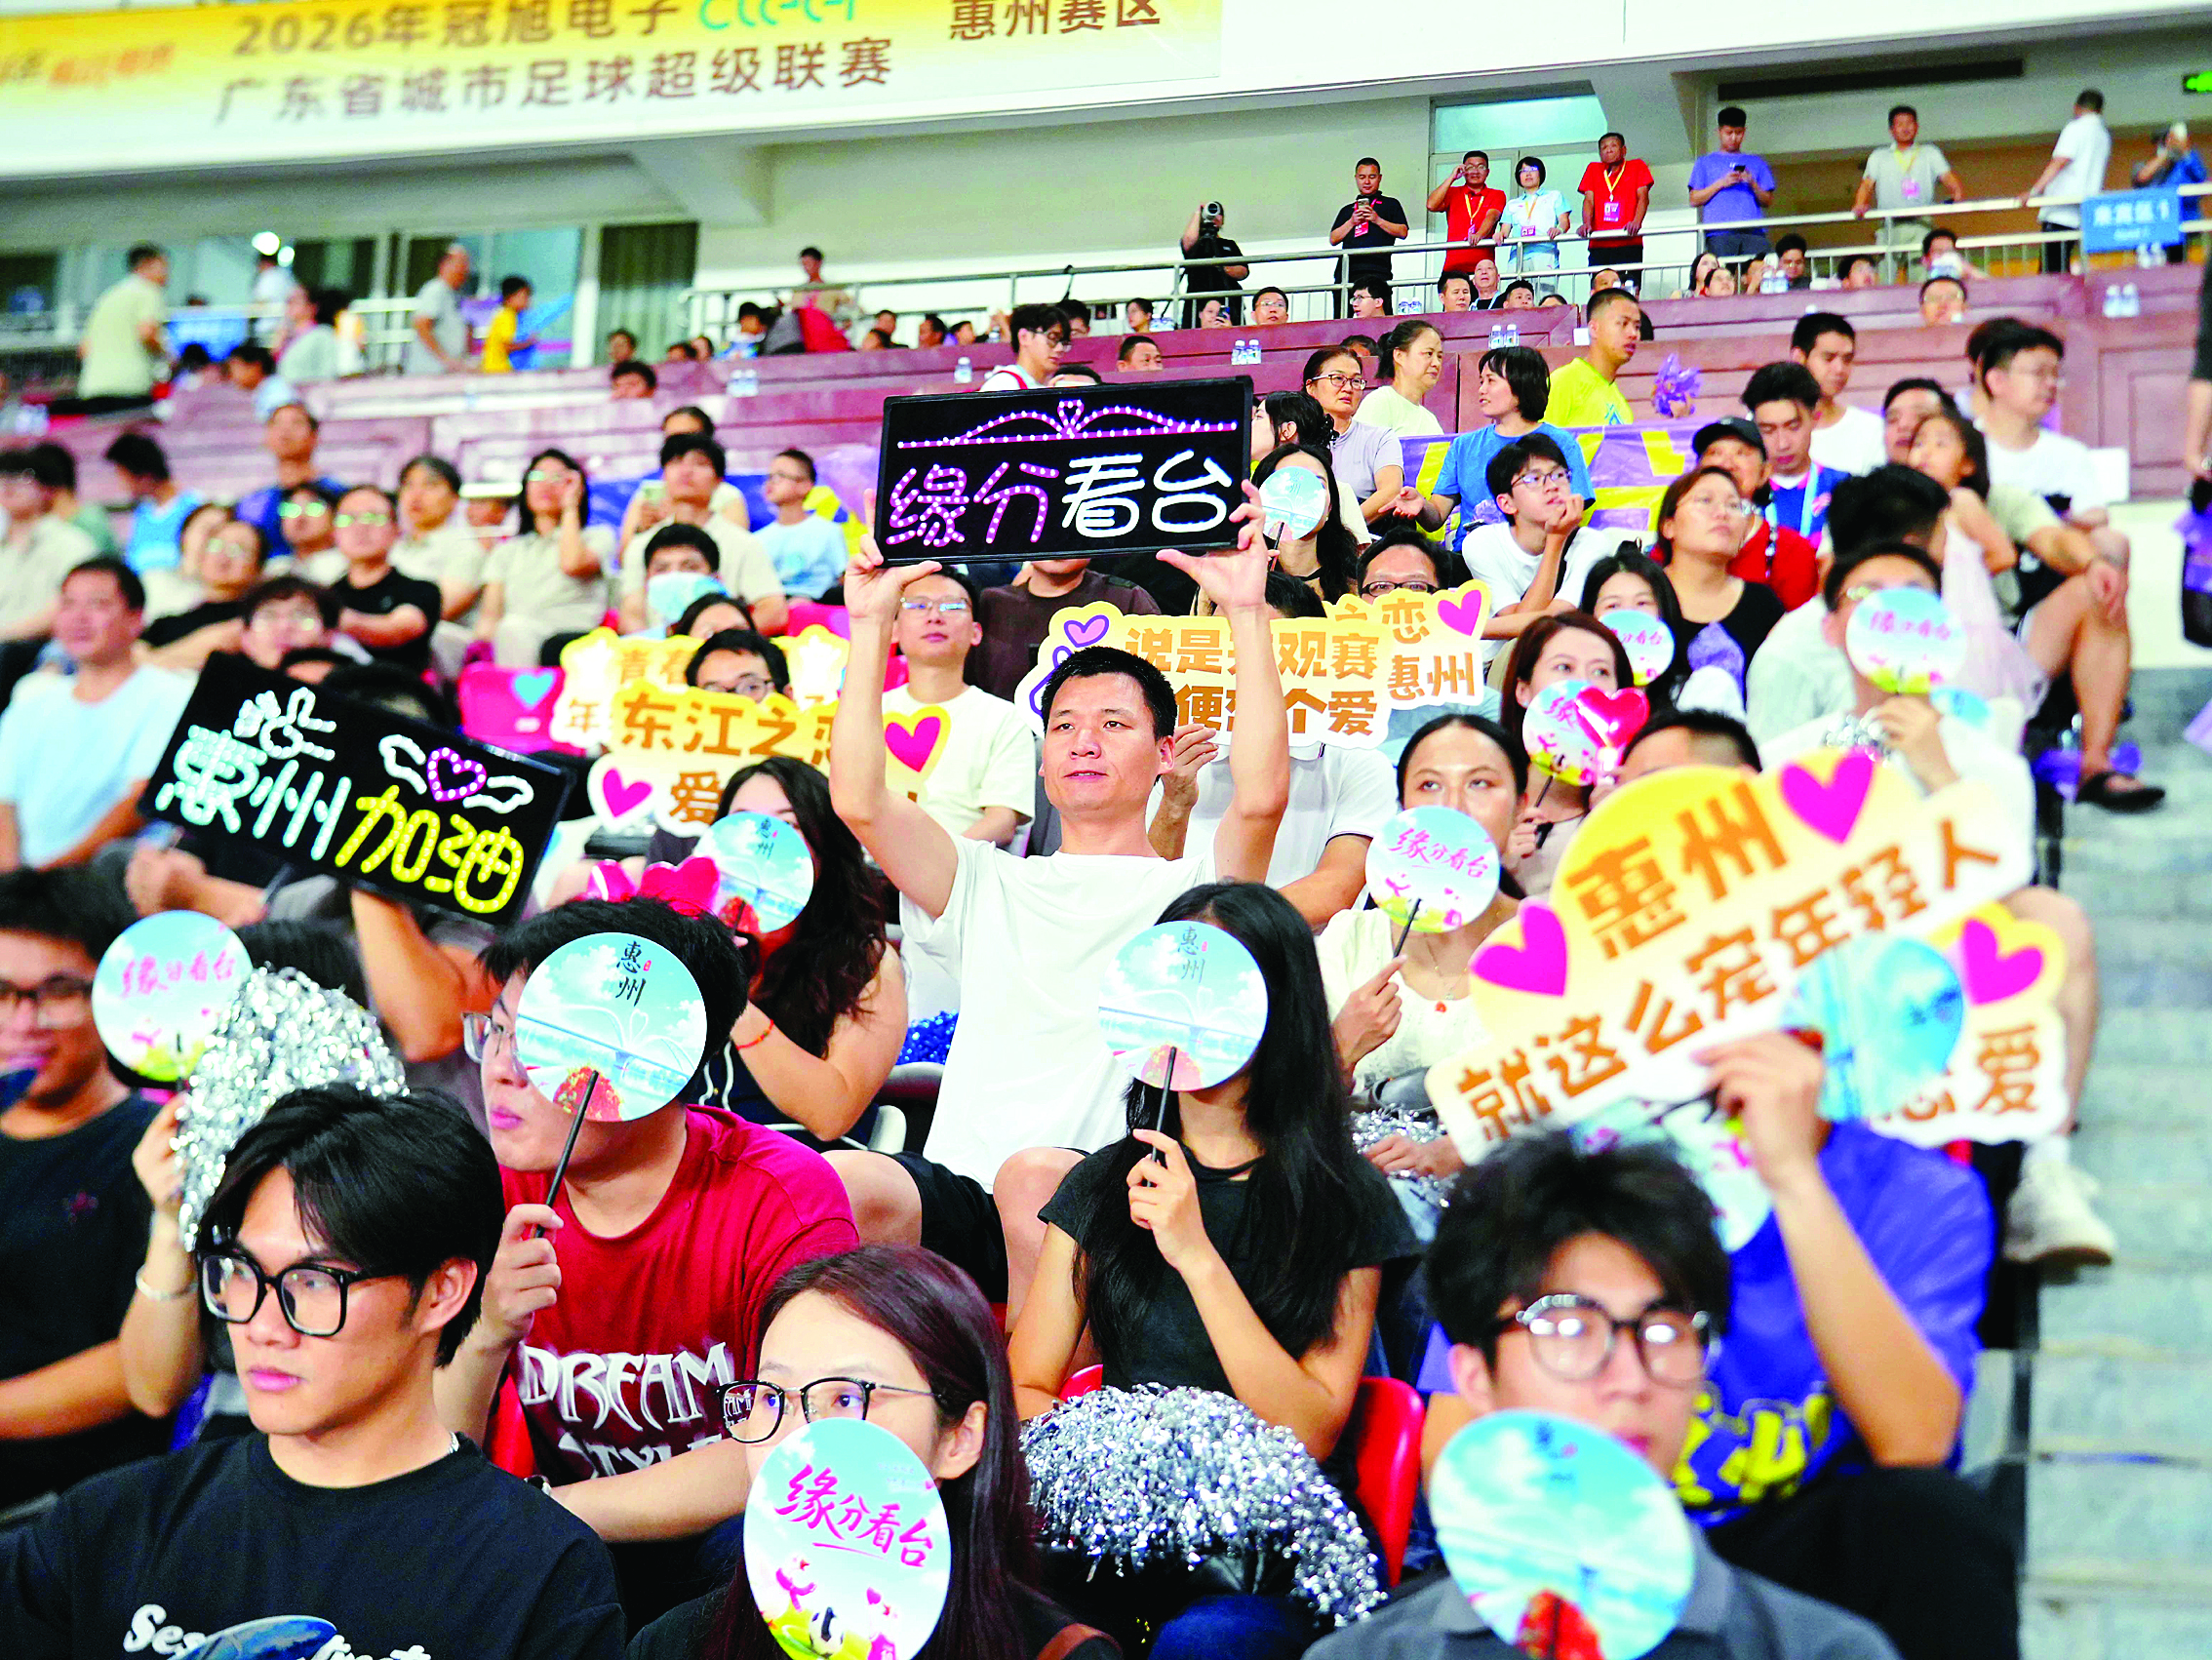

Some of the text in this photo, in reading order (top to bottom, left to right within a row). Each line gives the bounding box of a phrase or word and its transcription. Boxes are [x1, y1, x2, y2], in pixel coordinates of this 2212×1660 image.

[949, 0, 1162, 41] 惠州赛区
[215, 38, 892, 128] 广东省城市足球超级联赛
[886, 450, 1232, 546] 缘分看台
[1387, 652, 1476, 701] 惠州
[1611, 628, 1663, 646] 分看台
[155, 723, 526, 914] 惠州加油
[669, 771, 723, 825] 爱
[1389, 828, 1489, 878] 缘分看台
[1566, 781, 1789, 960] 惠州
[615, 940, 647, 1008] 惠州
[1177, 925, 1205, 983] 惠州
[1457, 817, 1999, 1143] 就这么宠年轻人
[519, 1341, 732, 1432] DREAM
[773, 1464, 933, 1567] 缘分看台
